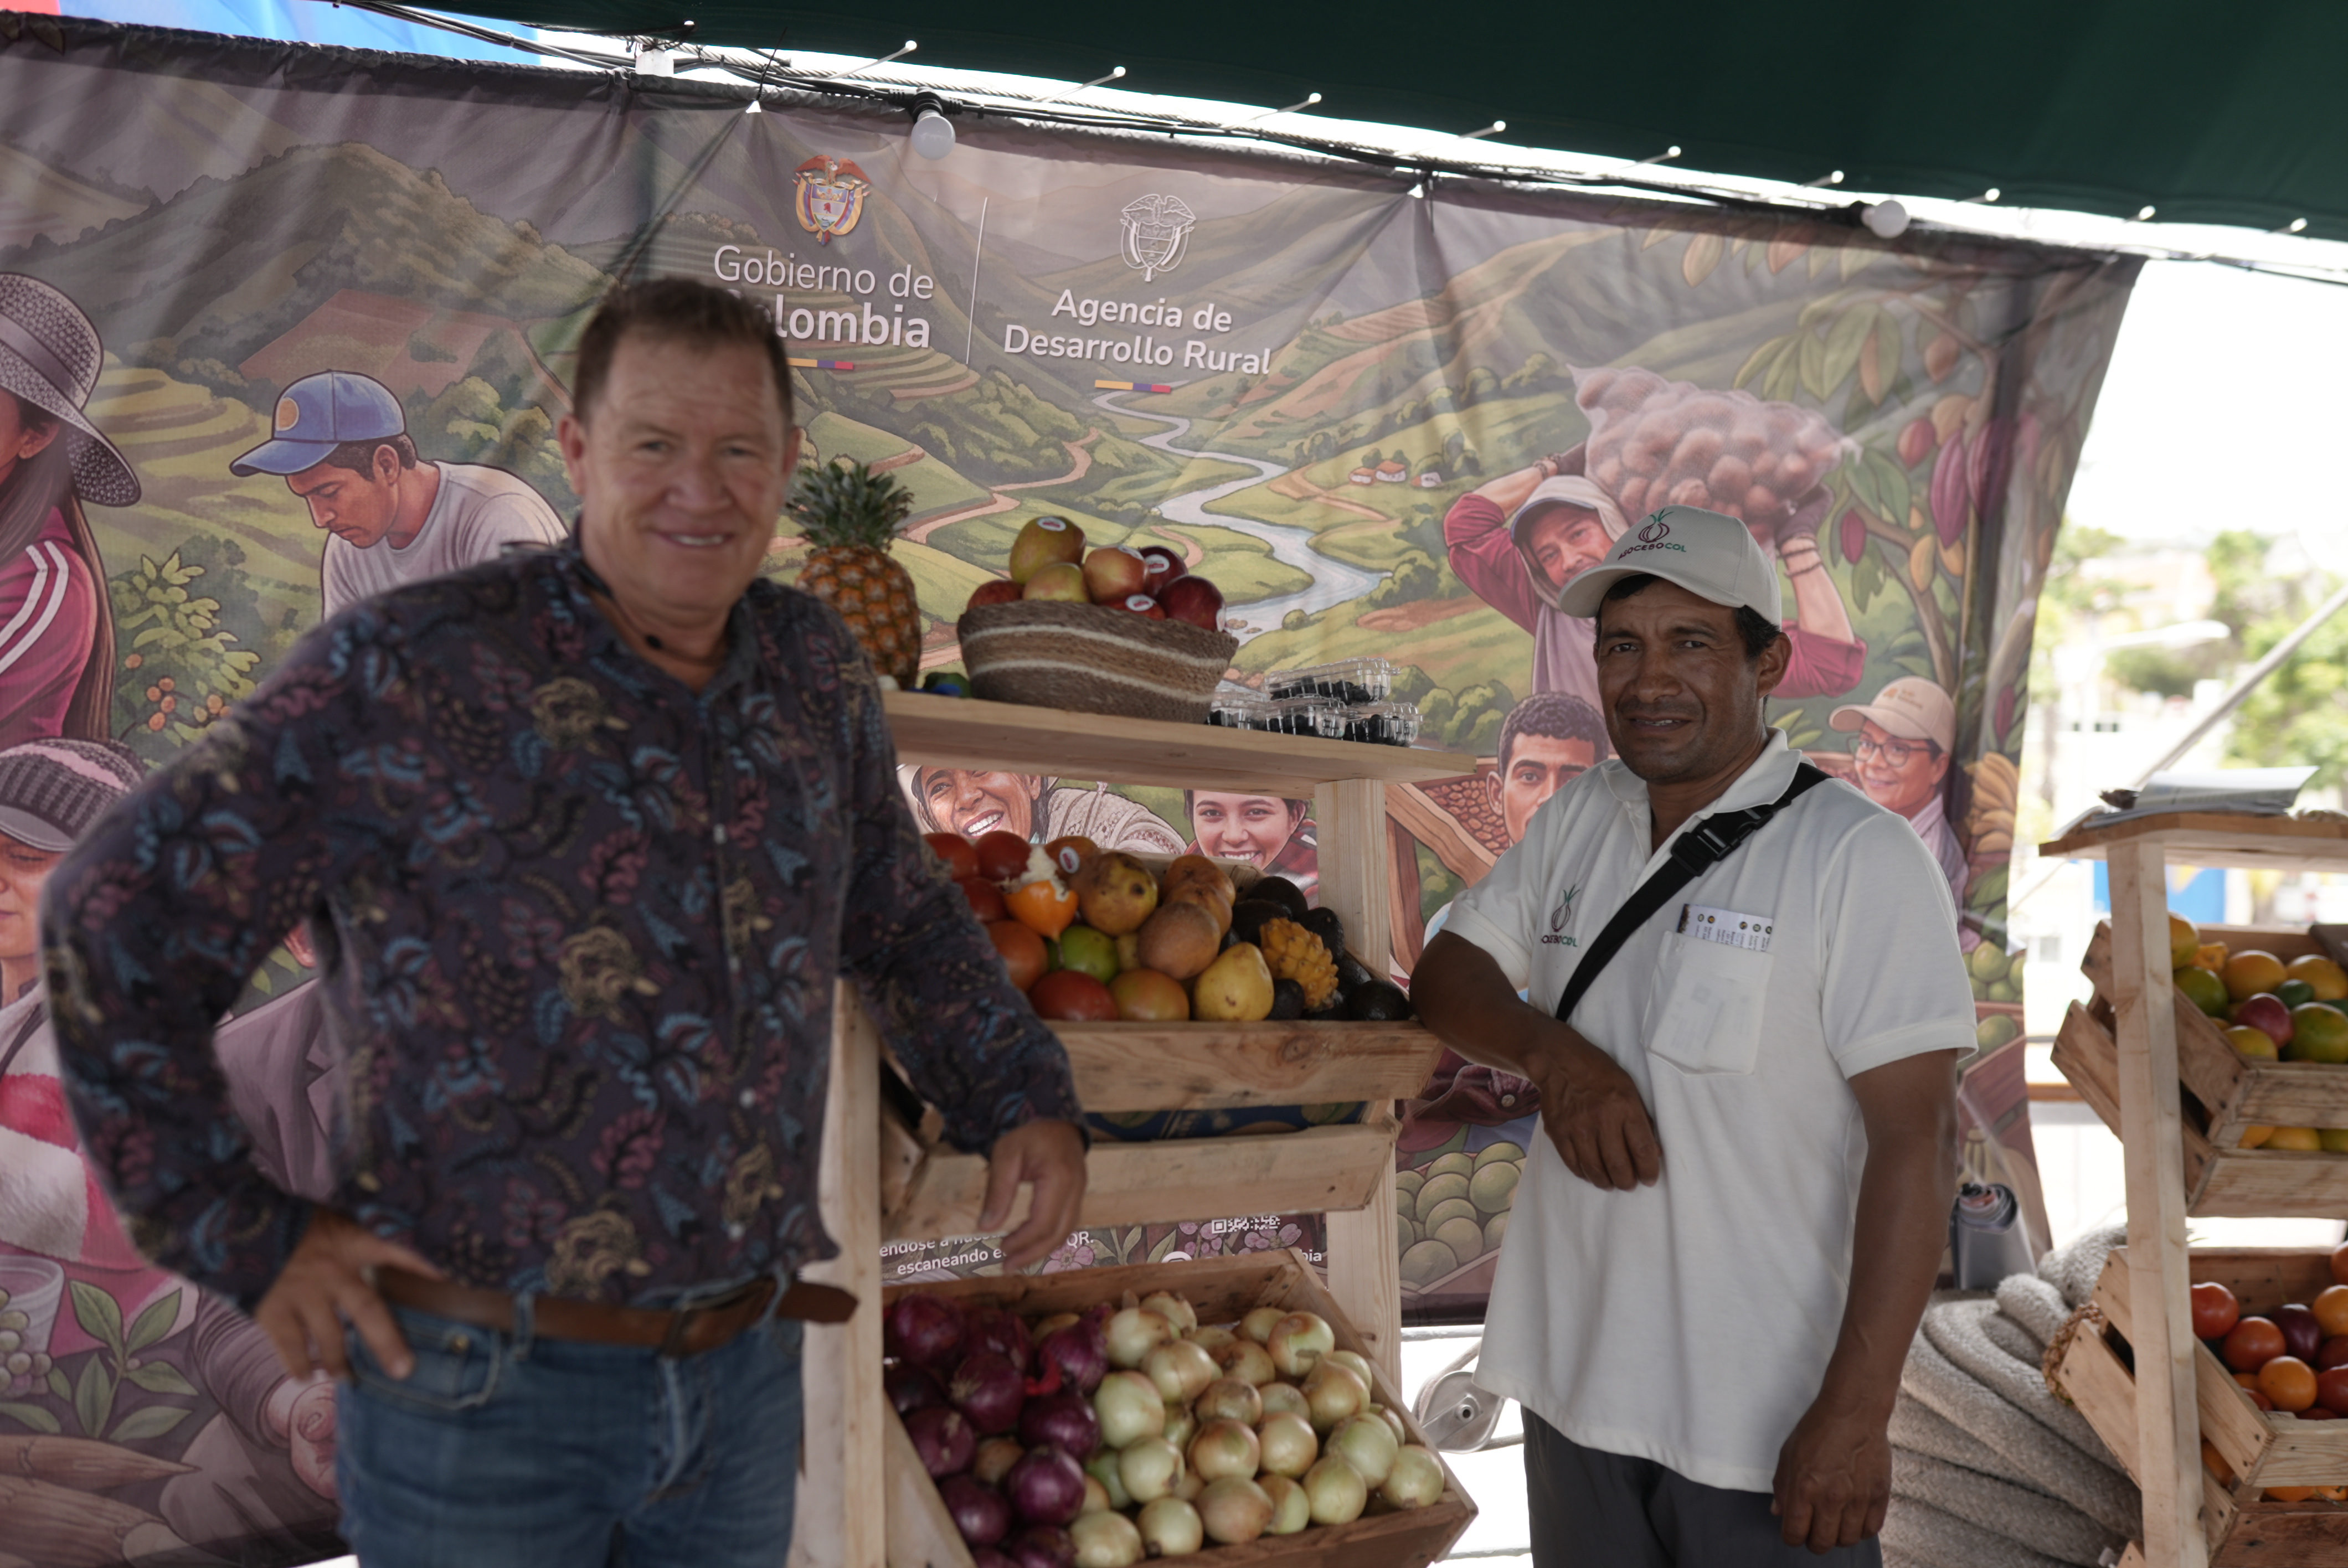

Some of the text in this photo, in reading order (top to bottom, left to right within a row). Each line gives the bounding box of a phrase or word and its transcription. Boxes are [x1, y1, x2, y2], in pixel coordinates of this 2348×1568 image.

[714, 245, 934, 300] Gobierno de
[727, 288, 930, 349] lombia
[1051, 288, 1232, 332] Agencia de
[1004, 324, 1271, 375] Desarrollo Rural
[879, 1240, 936, 1257] endose
[897, 1248, 988, 1276] escaneando
[1066, 1231, 1094, 1249] QR.
